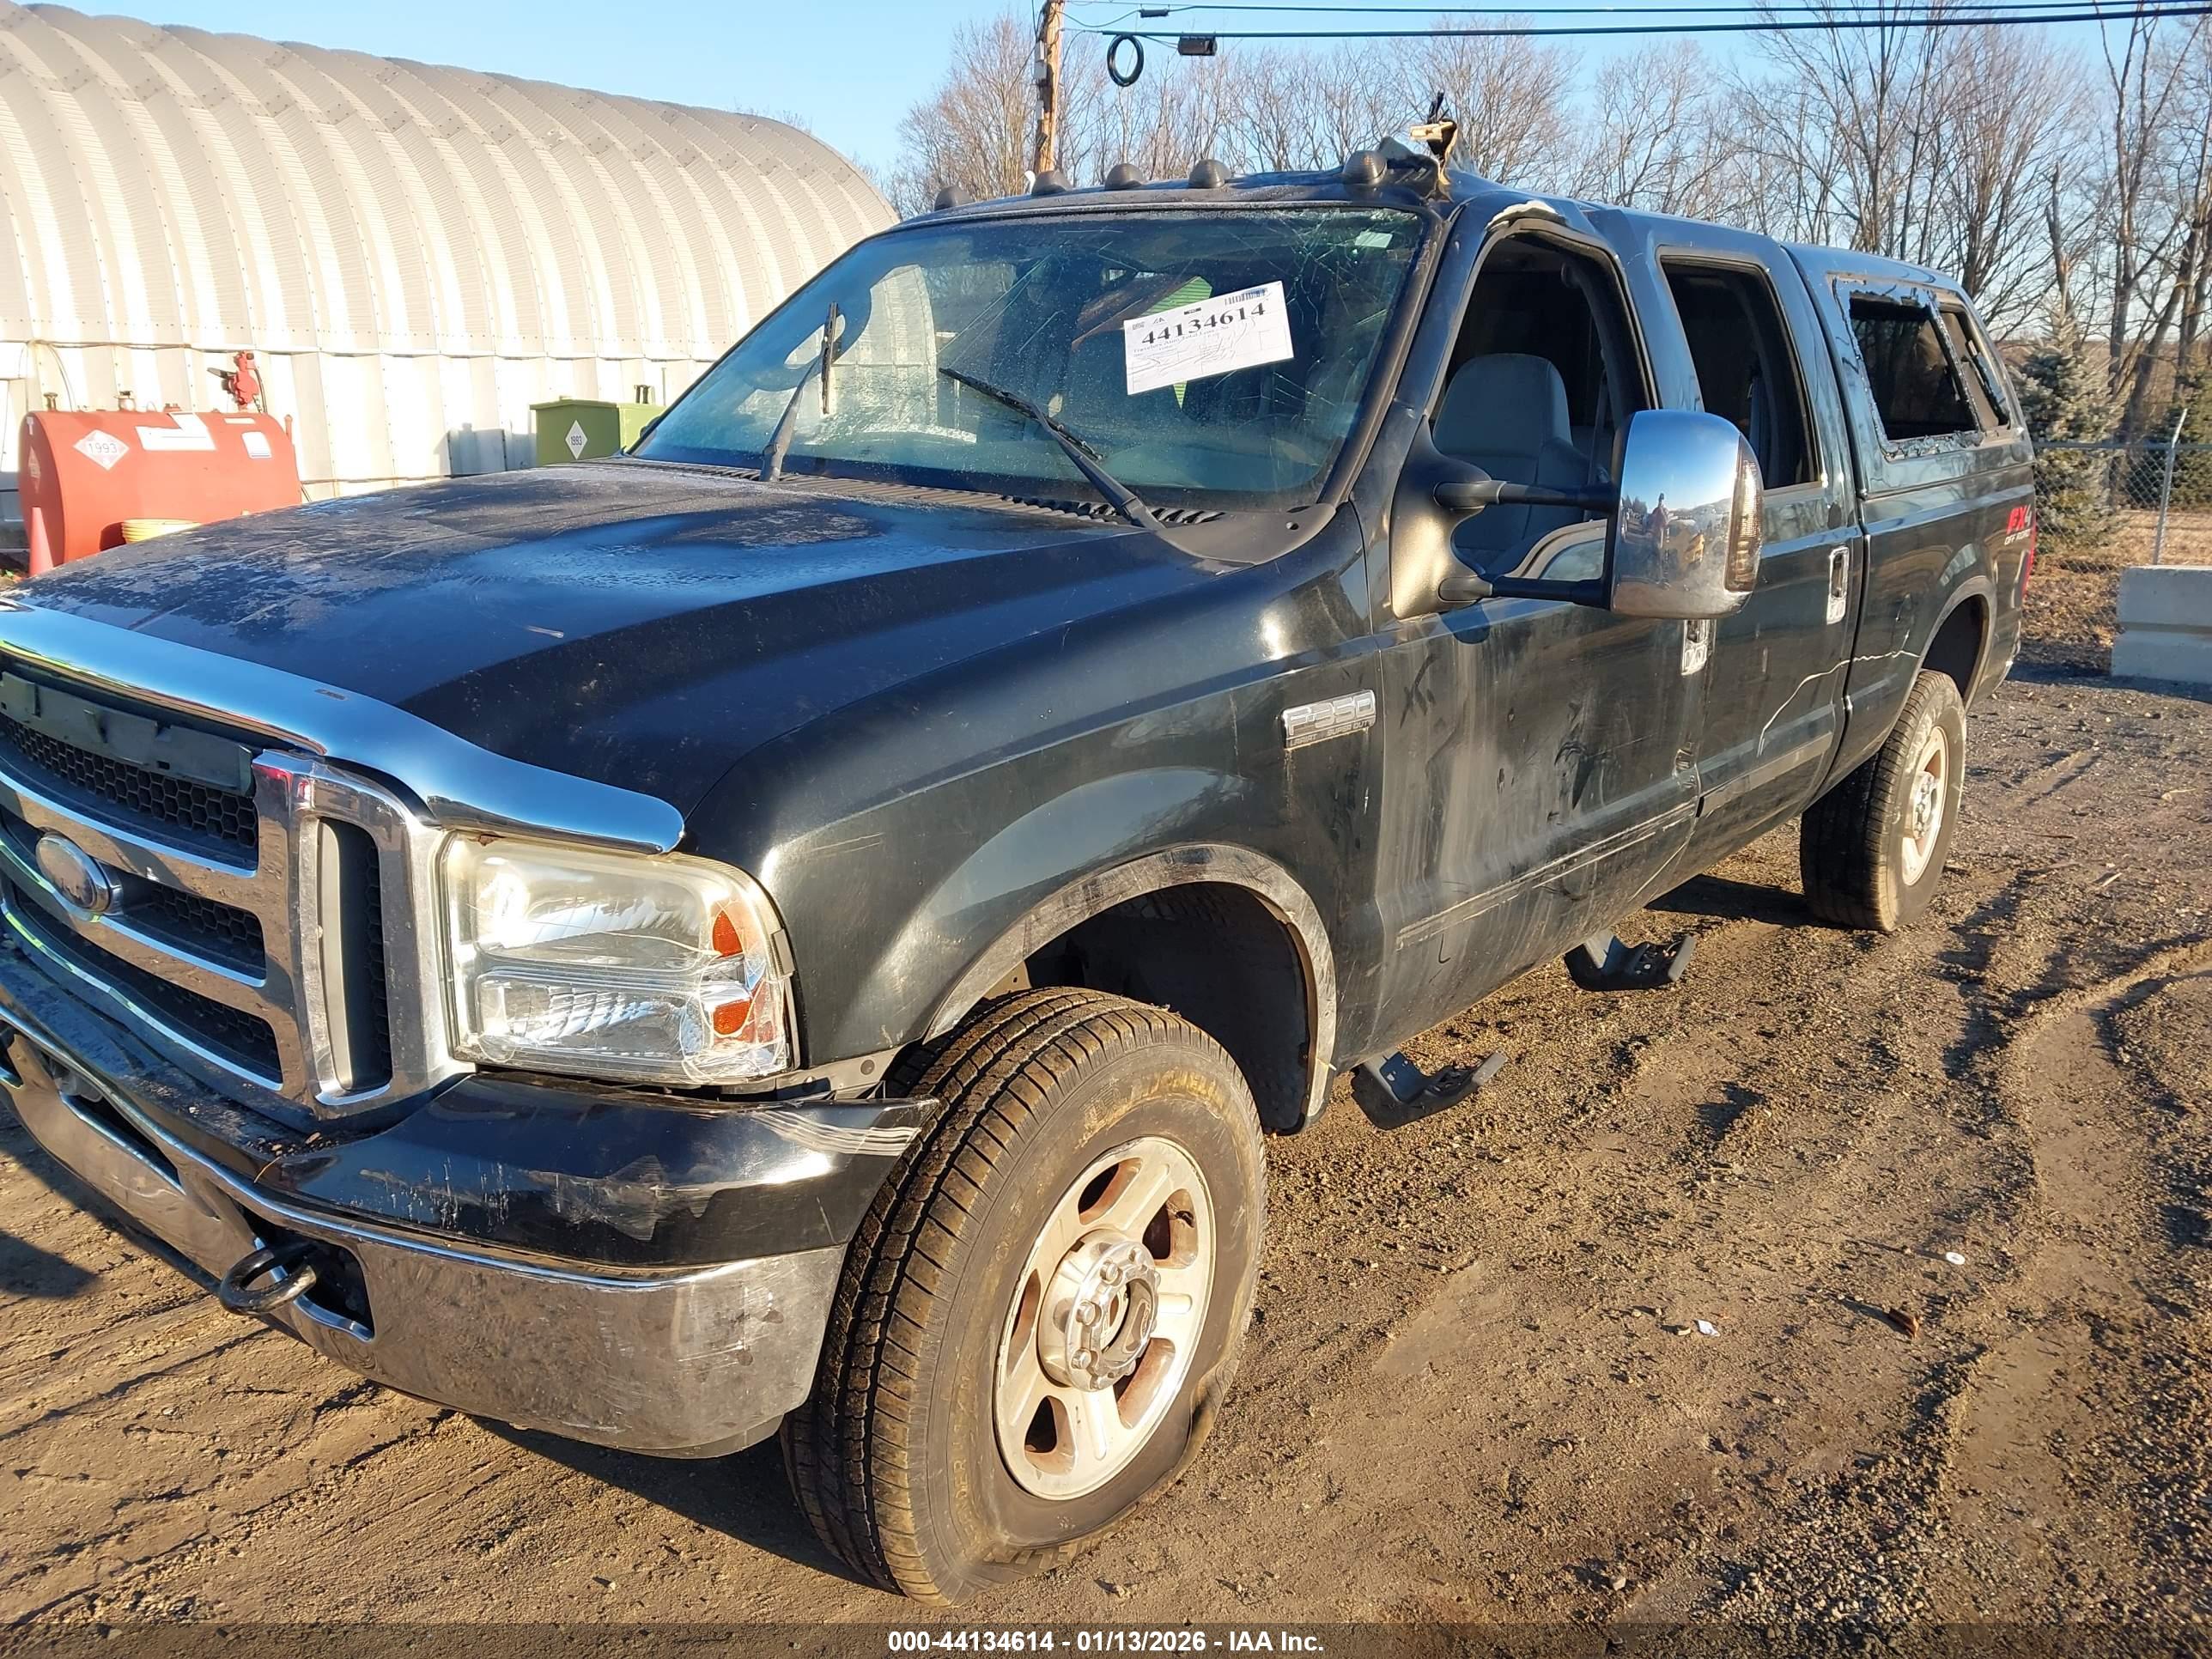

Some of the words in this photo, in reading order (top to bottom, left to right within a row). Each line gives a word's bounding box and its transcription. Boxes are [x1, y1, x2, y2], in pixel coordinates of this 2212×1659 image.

[1142, 302, 1266, 344] 44134614
[88, 442, 118, 453] 1993
[2006, 504, 2033, 534] FX4
[1327, 724, 1352, 737] SUPER
